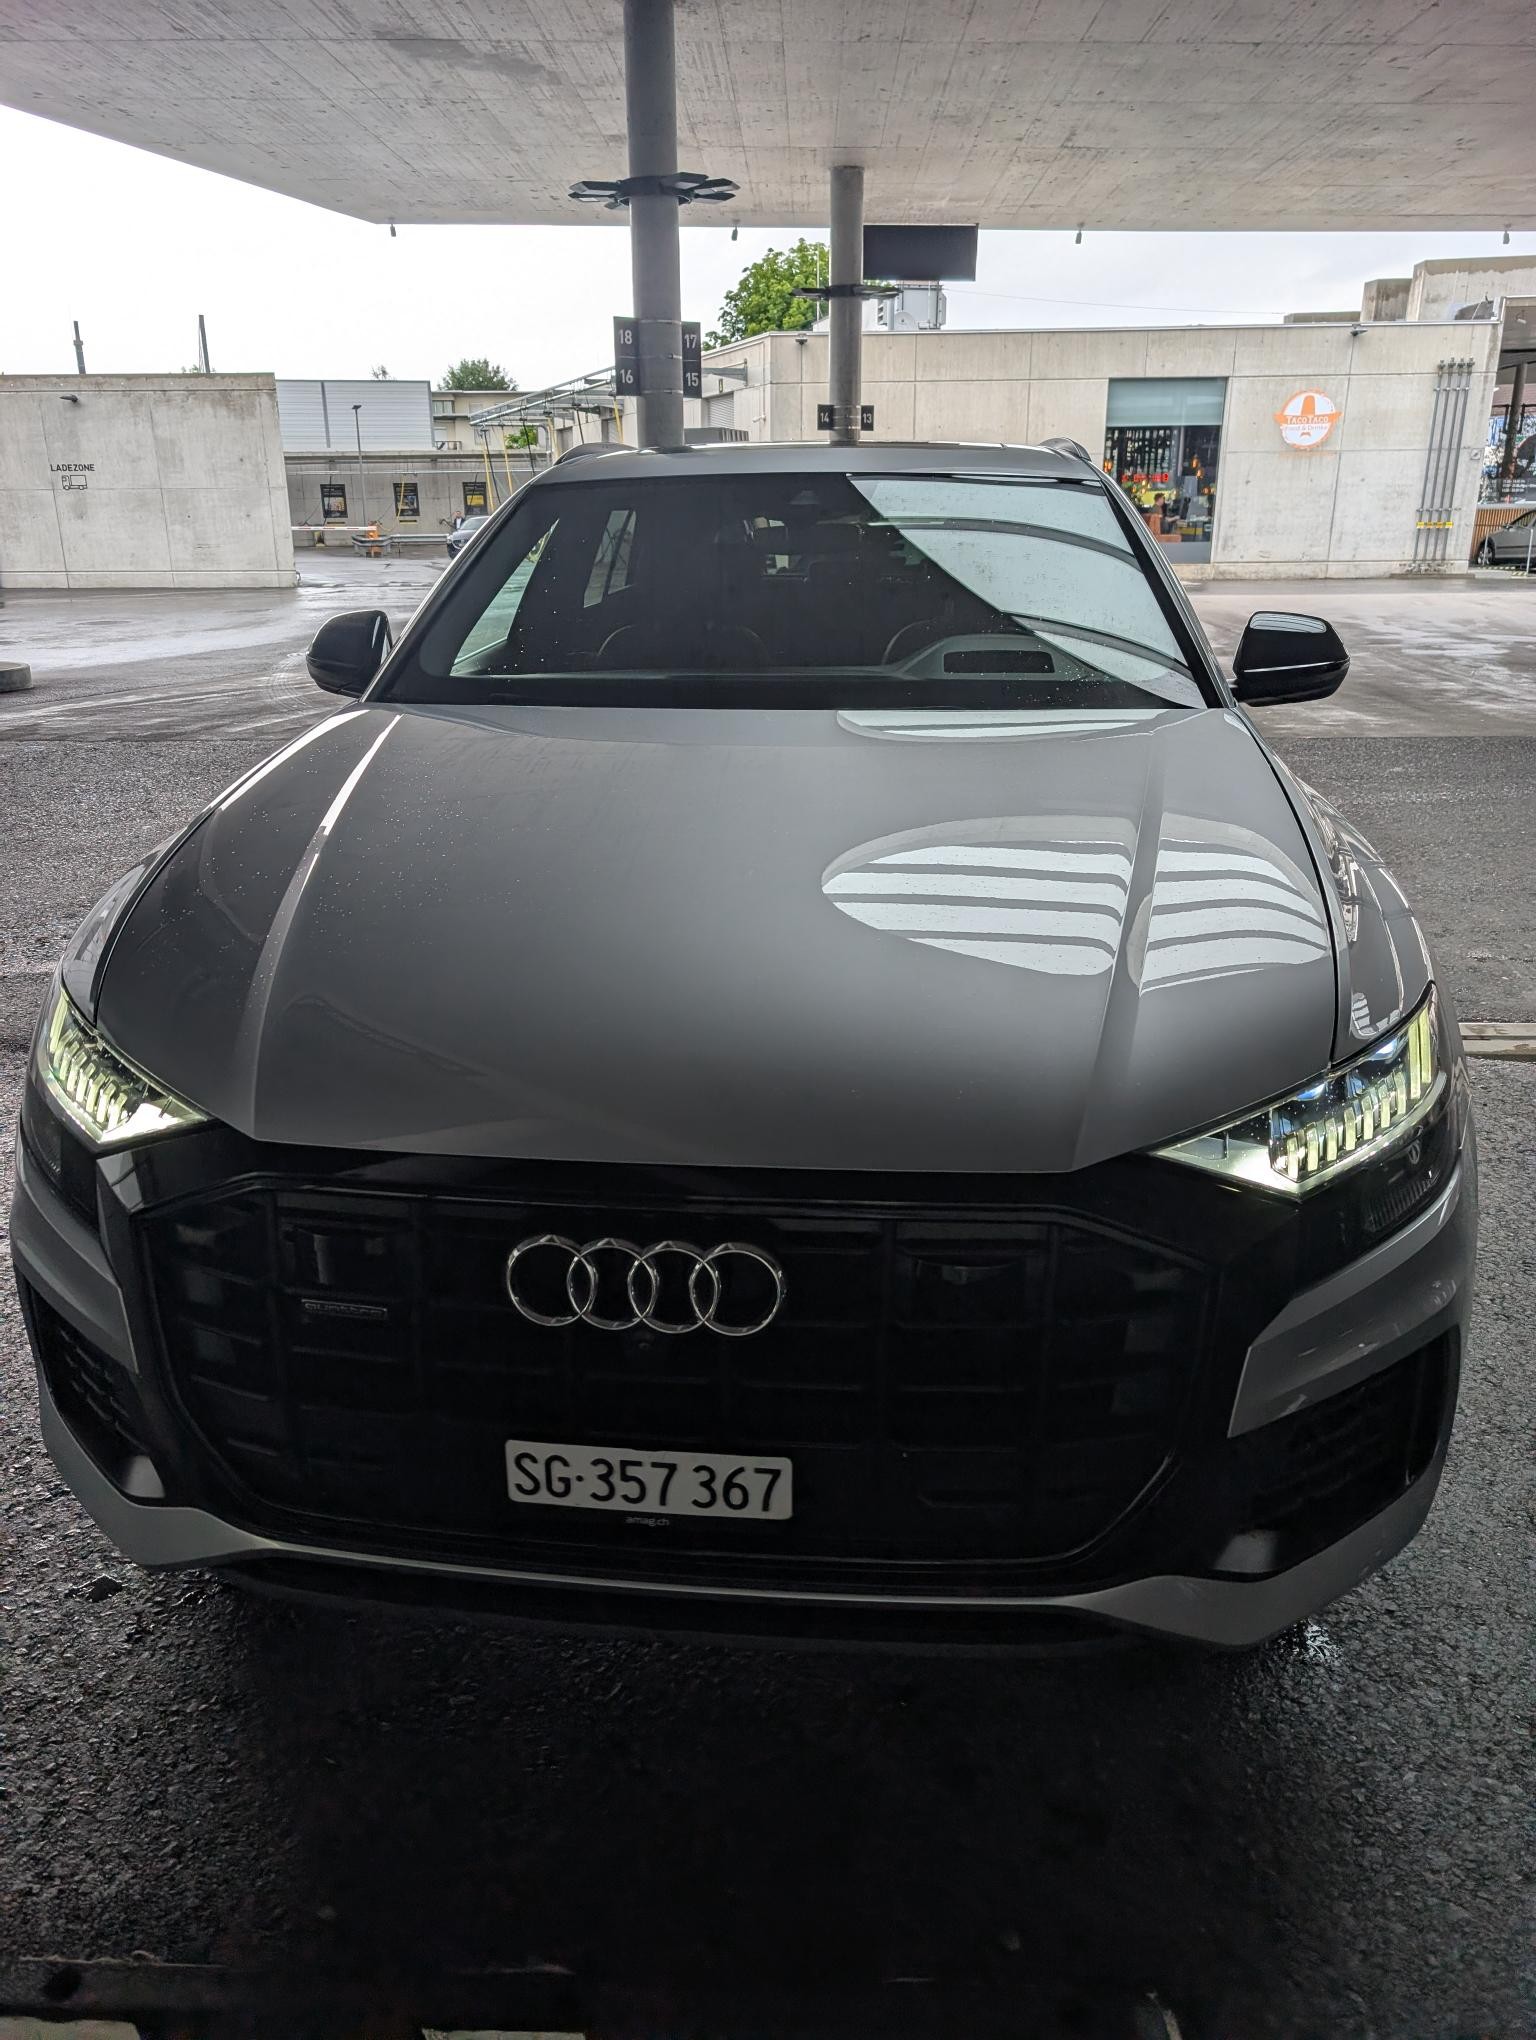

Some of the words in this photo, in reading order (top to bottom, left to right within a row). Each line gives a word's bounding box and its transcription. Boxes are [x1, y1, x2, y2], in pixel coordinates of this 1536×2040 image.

[618, 329, 633, 345] 18
[684, 333, 698, 349] 17
[619, 368, 634, 384] 16
[685, 372, 699, 387] 15
[820, 412, 830, 422] 14
[862, 412, 872, 422] 13
[50, 464, 96, 472] LADEZONE
[691, 1464, 782, 1512] 367
